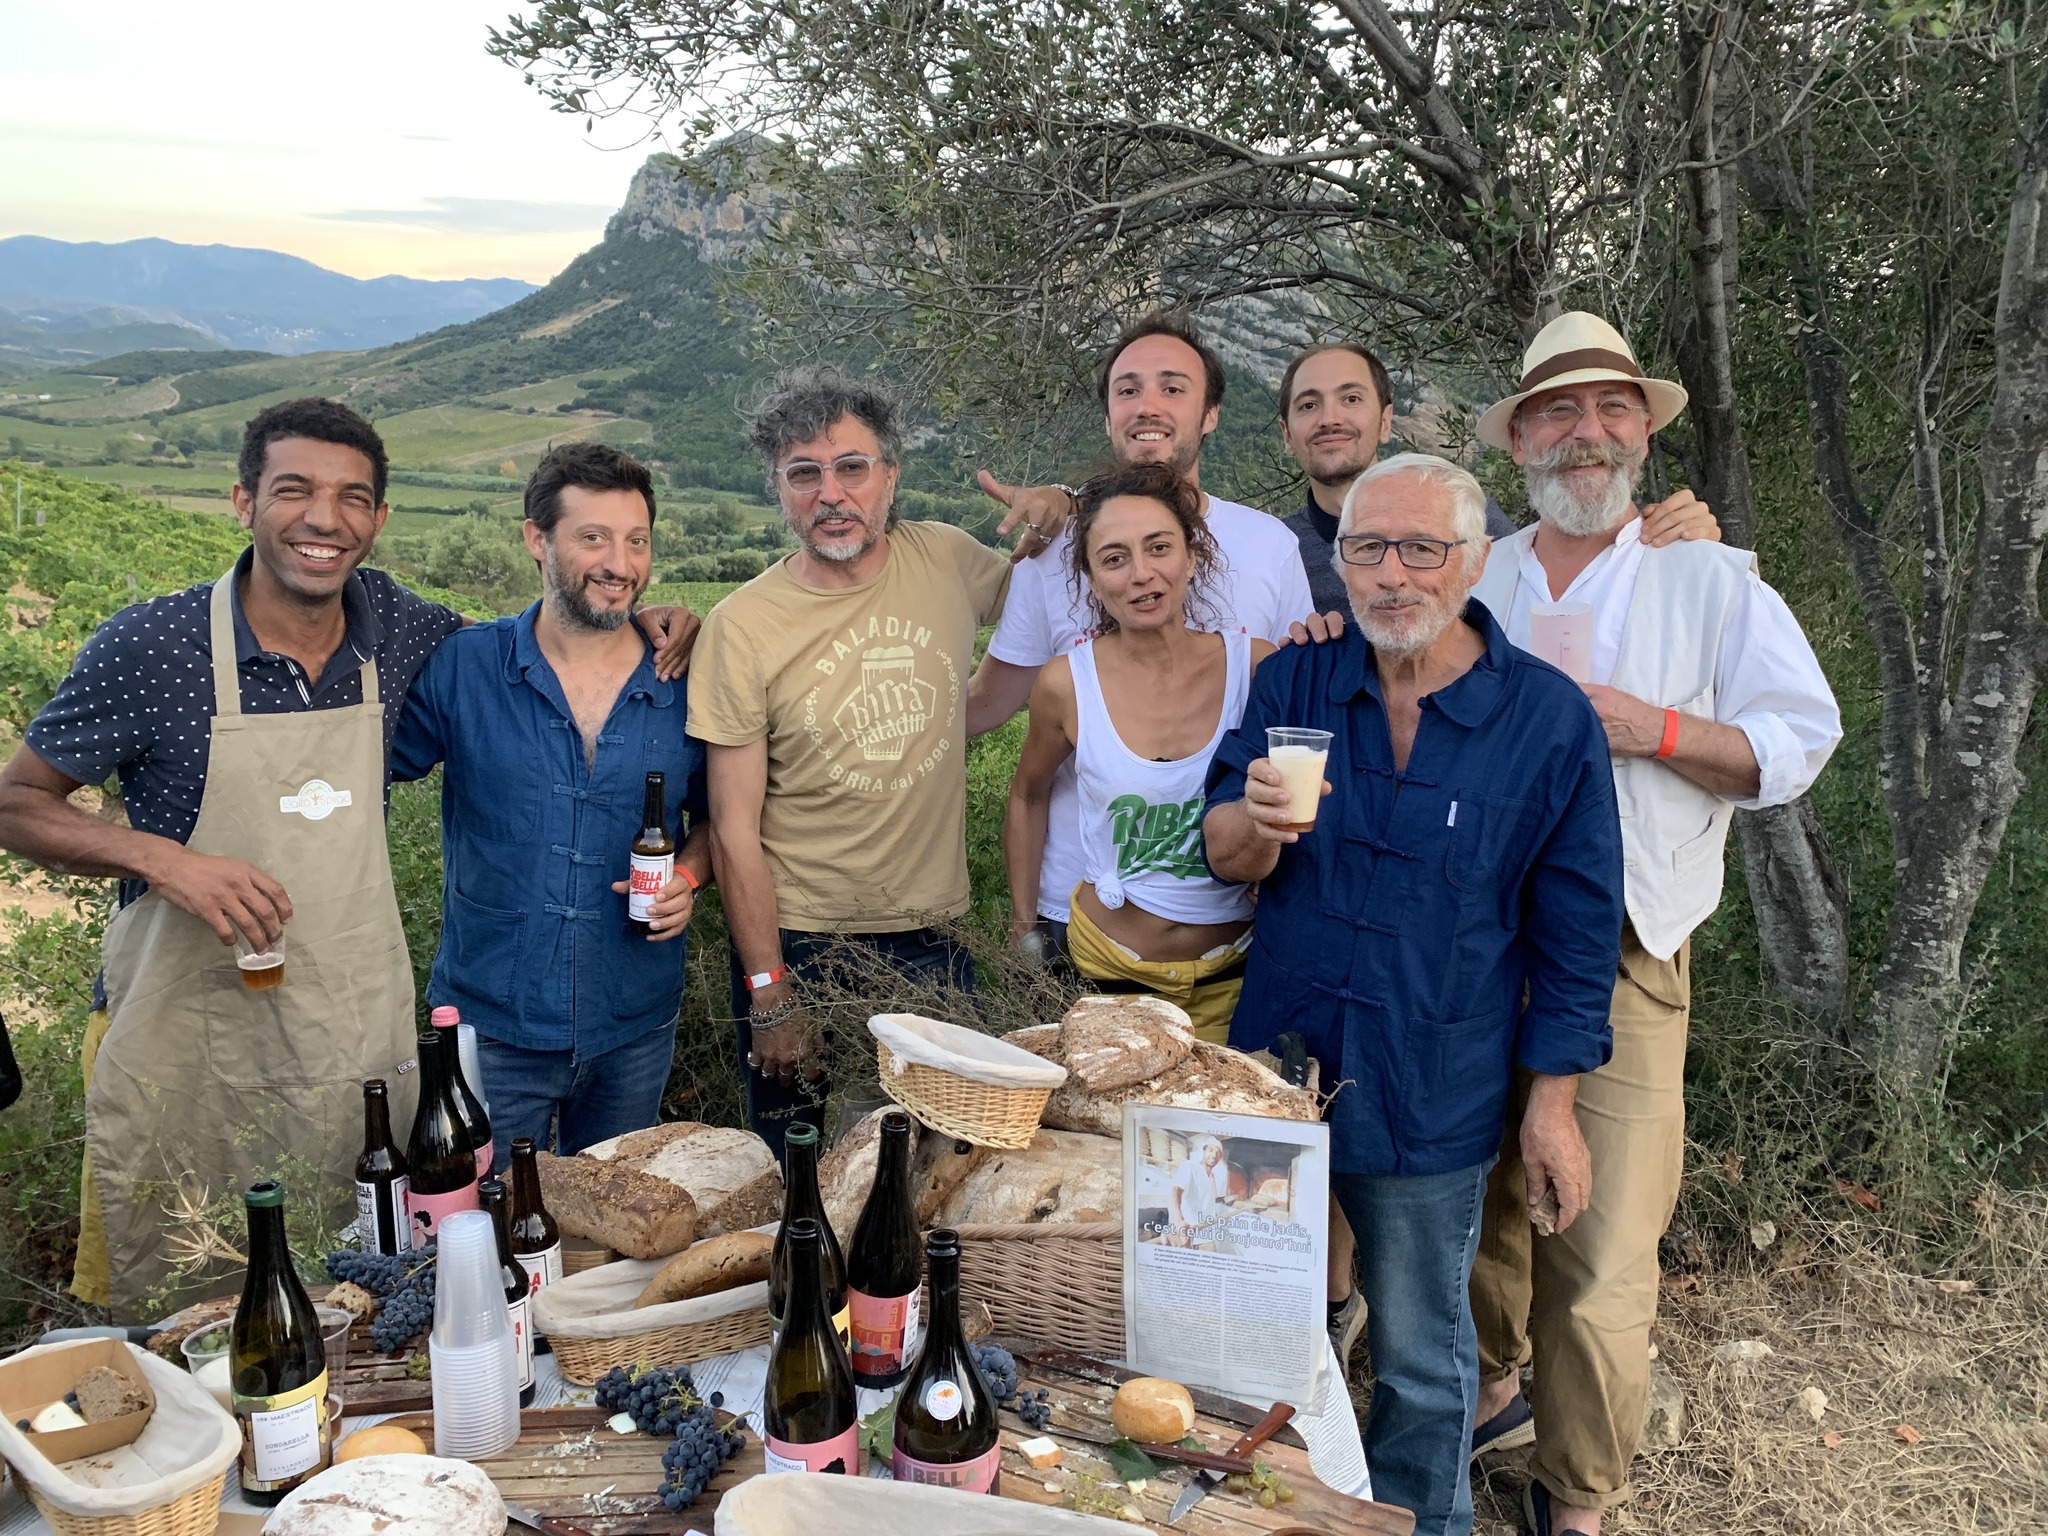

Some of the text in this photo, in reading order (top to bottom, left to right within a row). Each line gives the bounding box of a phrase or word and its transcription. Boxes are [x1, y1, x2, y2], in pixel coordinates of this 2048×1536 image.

[815, 616, 932, 676] BALADIN
[849, 679, 924, 729] birra
[851, 712, 926, 748] baladin
[829, 738, 950, 792] BIRRA dal 1996
[1107, 794, 1205, 845] RIBE
[1143, 1220, 1312, 1254] c'est celui d'aujourd'hui
[1198, 1212, 1214, 1225] Le
[1217, 1215, 1249, 1230] pain
[1252, 1217, 1270, 1233] de
[1271, 1221, 1312, 1240] jadis,
